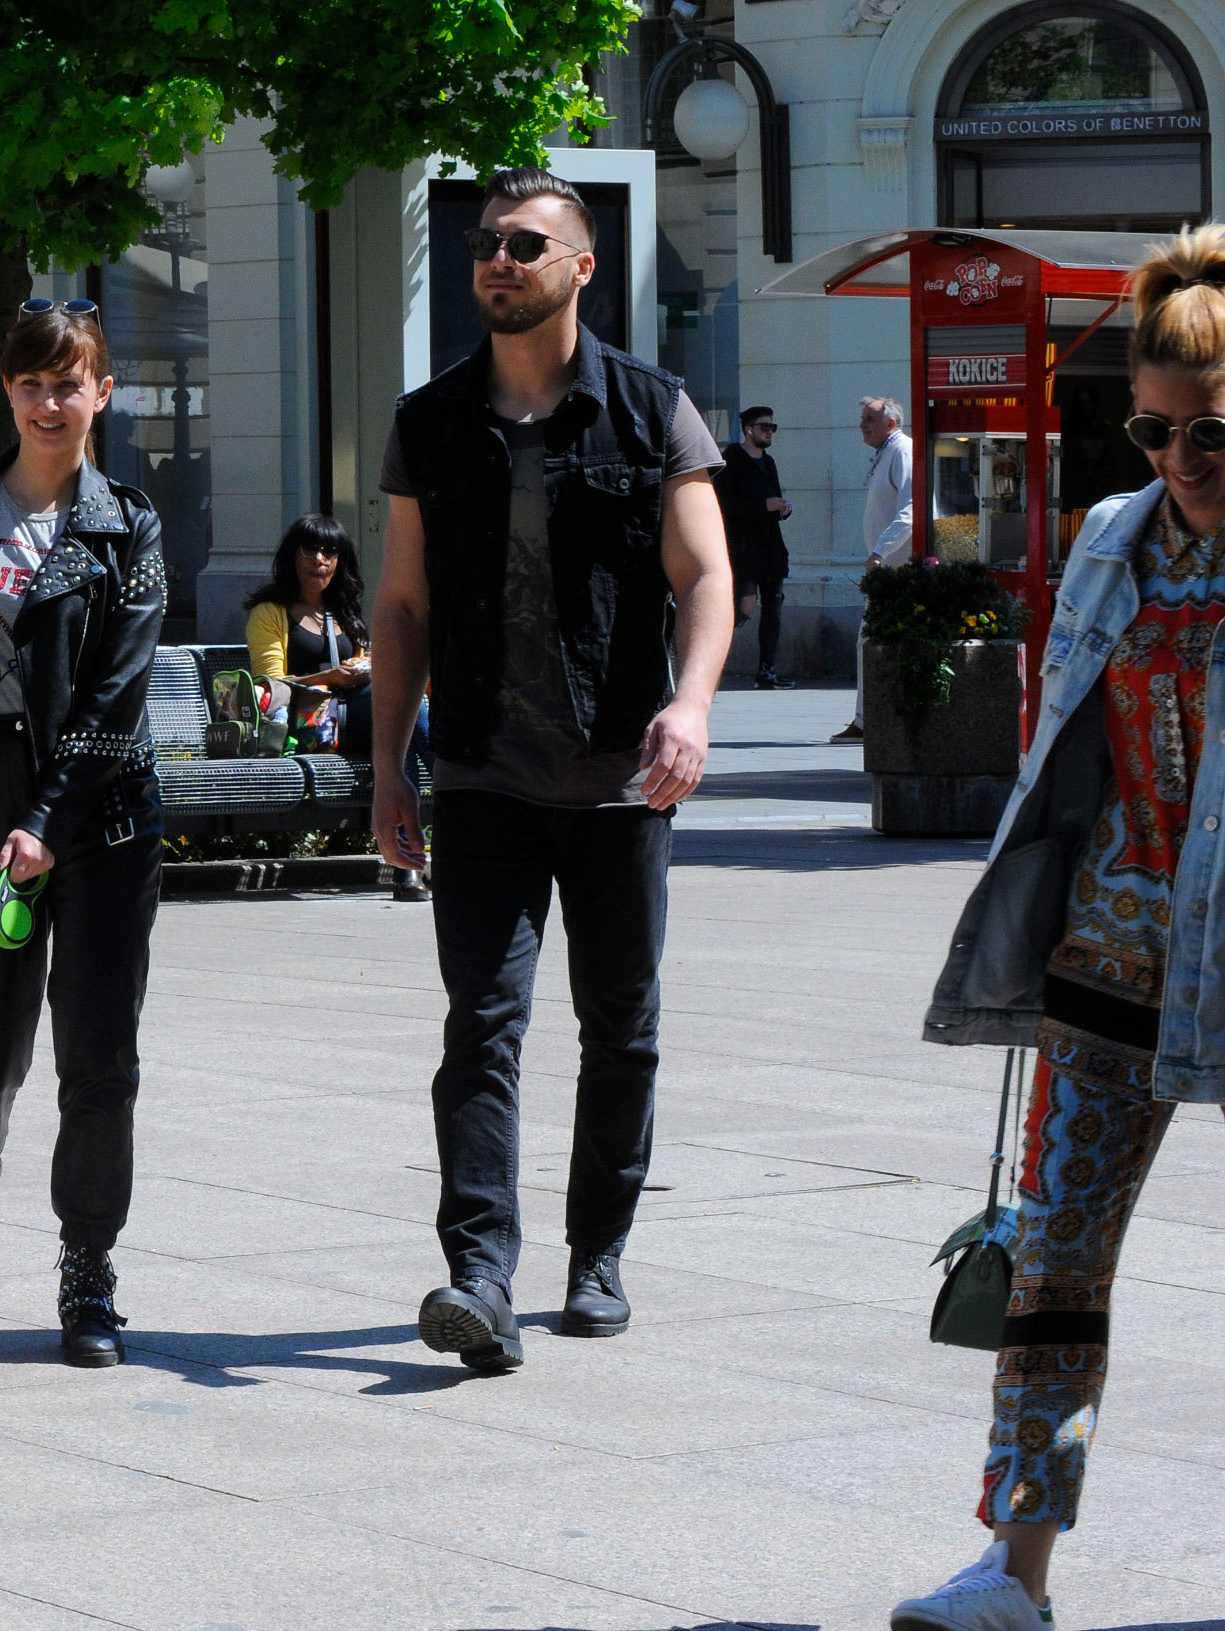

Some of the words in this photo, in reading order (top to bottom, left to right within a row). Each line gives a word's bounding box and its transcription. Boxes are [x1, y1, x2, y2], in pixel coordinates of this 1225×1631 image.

[941, 121, 1003, 136] UNITED
[1007, 119, 1078, 134] COLORS
[1082, 118, 1105, 132] OF
[1110, 115, 1202, 131] BENETTON
[955, 257, 988, 287] POP
[948, 357, 1007, 384] KOKICE
